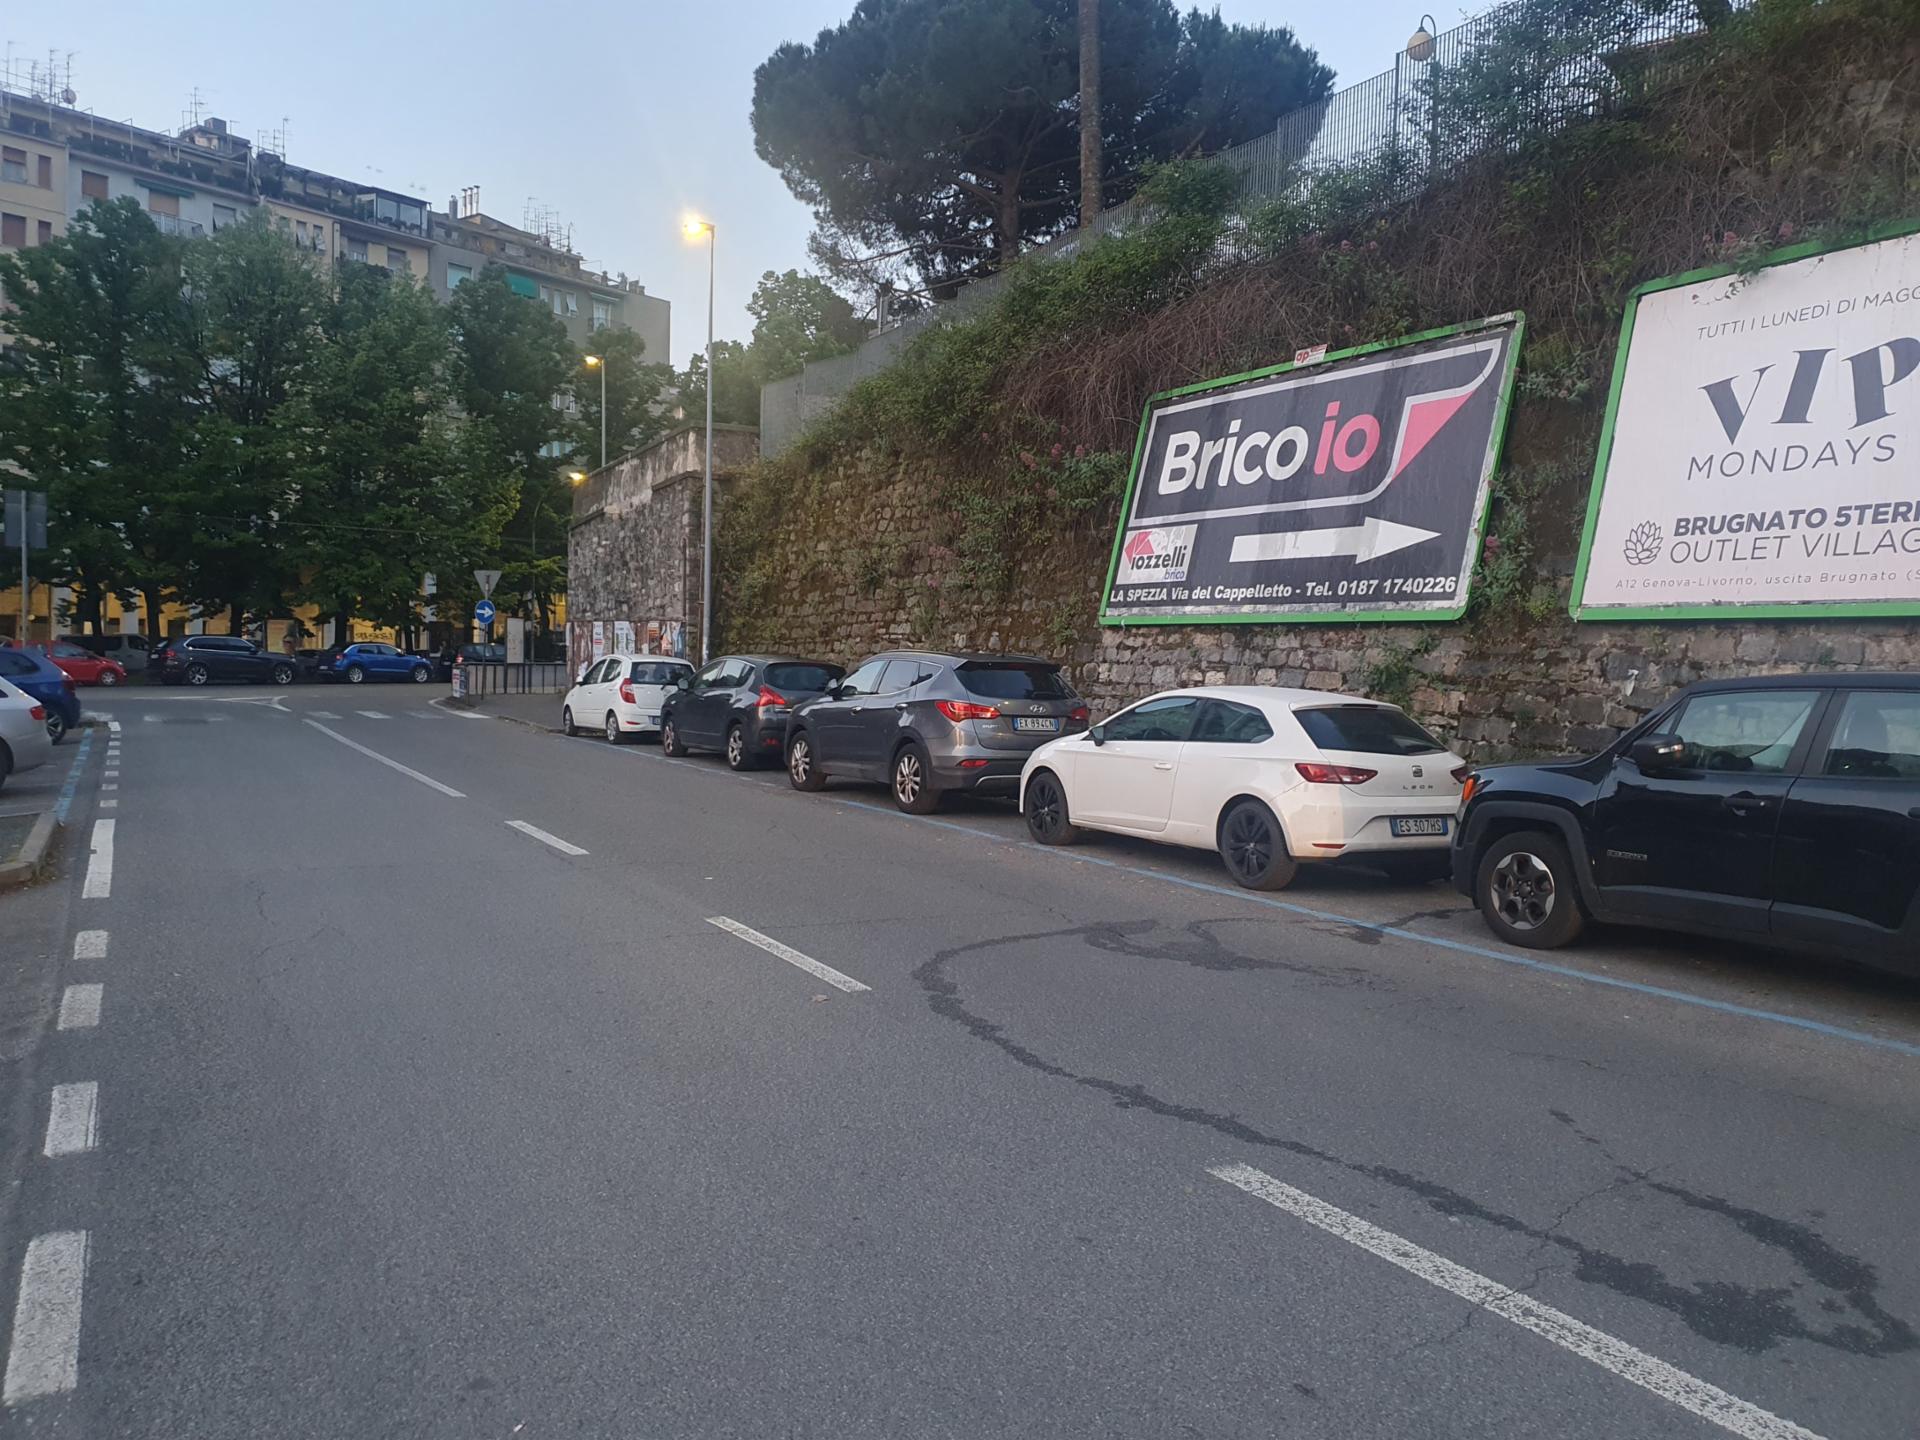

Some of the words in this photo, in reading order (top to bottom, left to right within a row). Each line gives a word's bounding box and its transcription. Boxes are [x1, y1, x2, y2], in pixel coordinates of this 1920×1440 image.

[1698, 319, 1746, 341] TUTTI
[1750, 317, 1756, 331] I
[1760, 300, 1831, 329] LUNEDÌ
[1837, 299, 1857, 314] DI
[1697, 336, 1920, 447] VIP
[1687, 433, 1897, 481] MONDAYS
[1673, 507, 1828, 537] BRUGNATO
[1670, 535, 1791, 564] OUTLET
[1110, 589, 1124, 602] LA
[1127, 587, 1168, 601] SPEZIA
[1171, 587, 1189, 600] Via
[1192, 585, 1211, 600] del
[1214, 583, 1292, 601] Cappelletto
[1305, 582, 1332, 597] Tel.
[1337, 580, 1379, 596] 0187
[1383, 576, 1457, 594] 1740226
[1164, 569, 1185, 580] brico
[1615, 578, 1637, 589] A12
[1765, 573, 1812, 585] uscita
[1820, 571, 1897, 584] Brugnato
